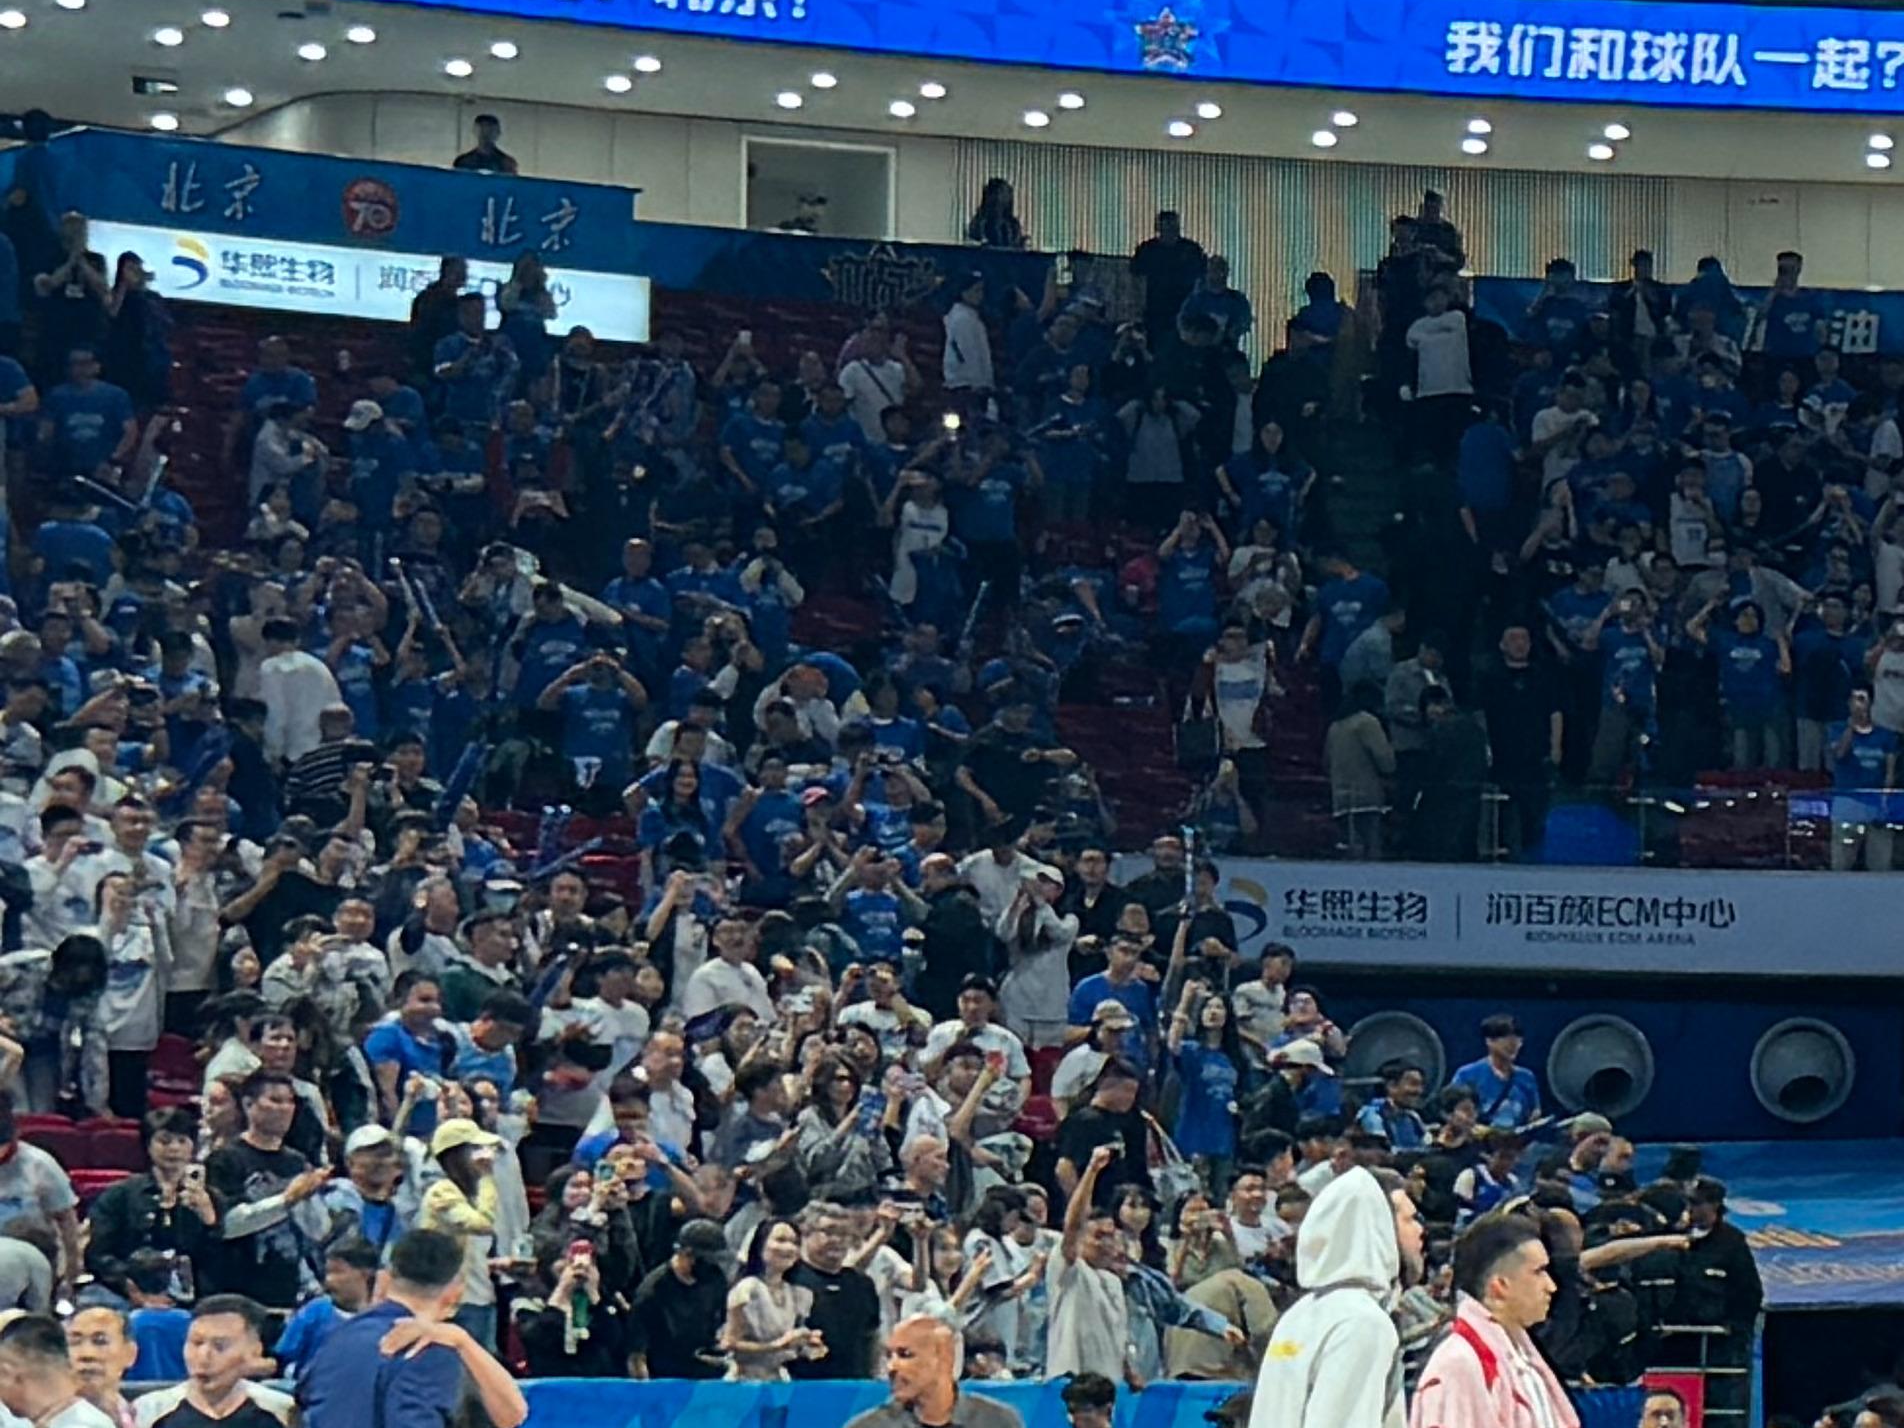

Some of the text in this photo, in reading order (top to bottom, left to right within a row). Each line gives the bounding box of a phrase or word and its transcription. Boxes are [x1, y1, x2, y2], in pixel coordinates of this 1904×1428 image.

[161, 160, 261, 221] 北京
[480, 195, 579, 252] 北京
[1283, 888, 1428, 925] 华熙生物
[1486, 891, 1737, 929] 润百颜ECM中心
